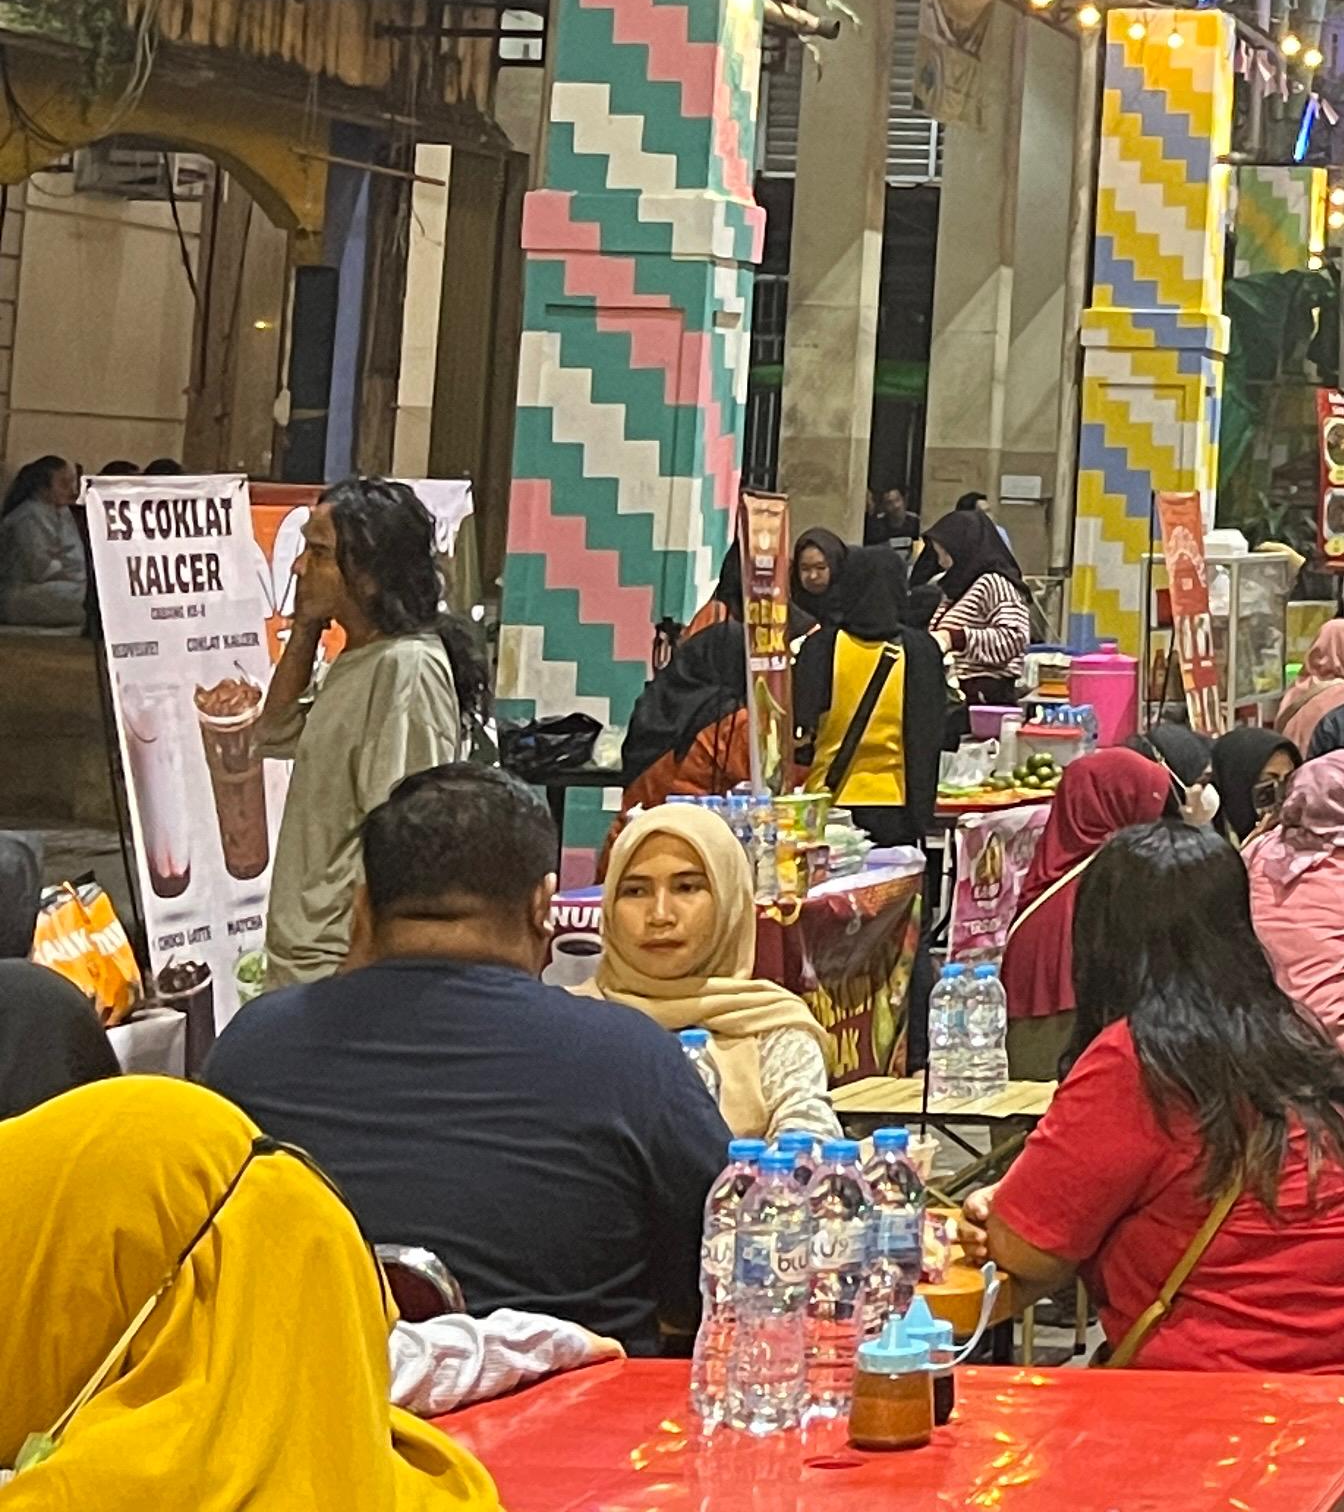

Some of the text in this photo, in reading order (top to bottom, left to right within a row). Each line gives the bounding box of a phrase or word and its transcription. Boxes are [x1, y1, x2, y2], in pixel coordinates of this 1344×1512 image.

[103, 497, 232, 541] ES COKLAT
[127, 553, 224, 596] KALCER
